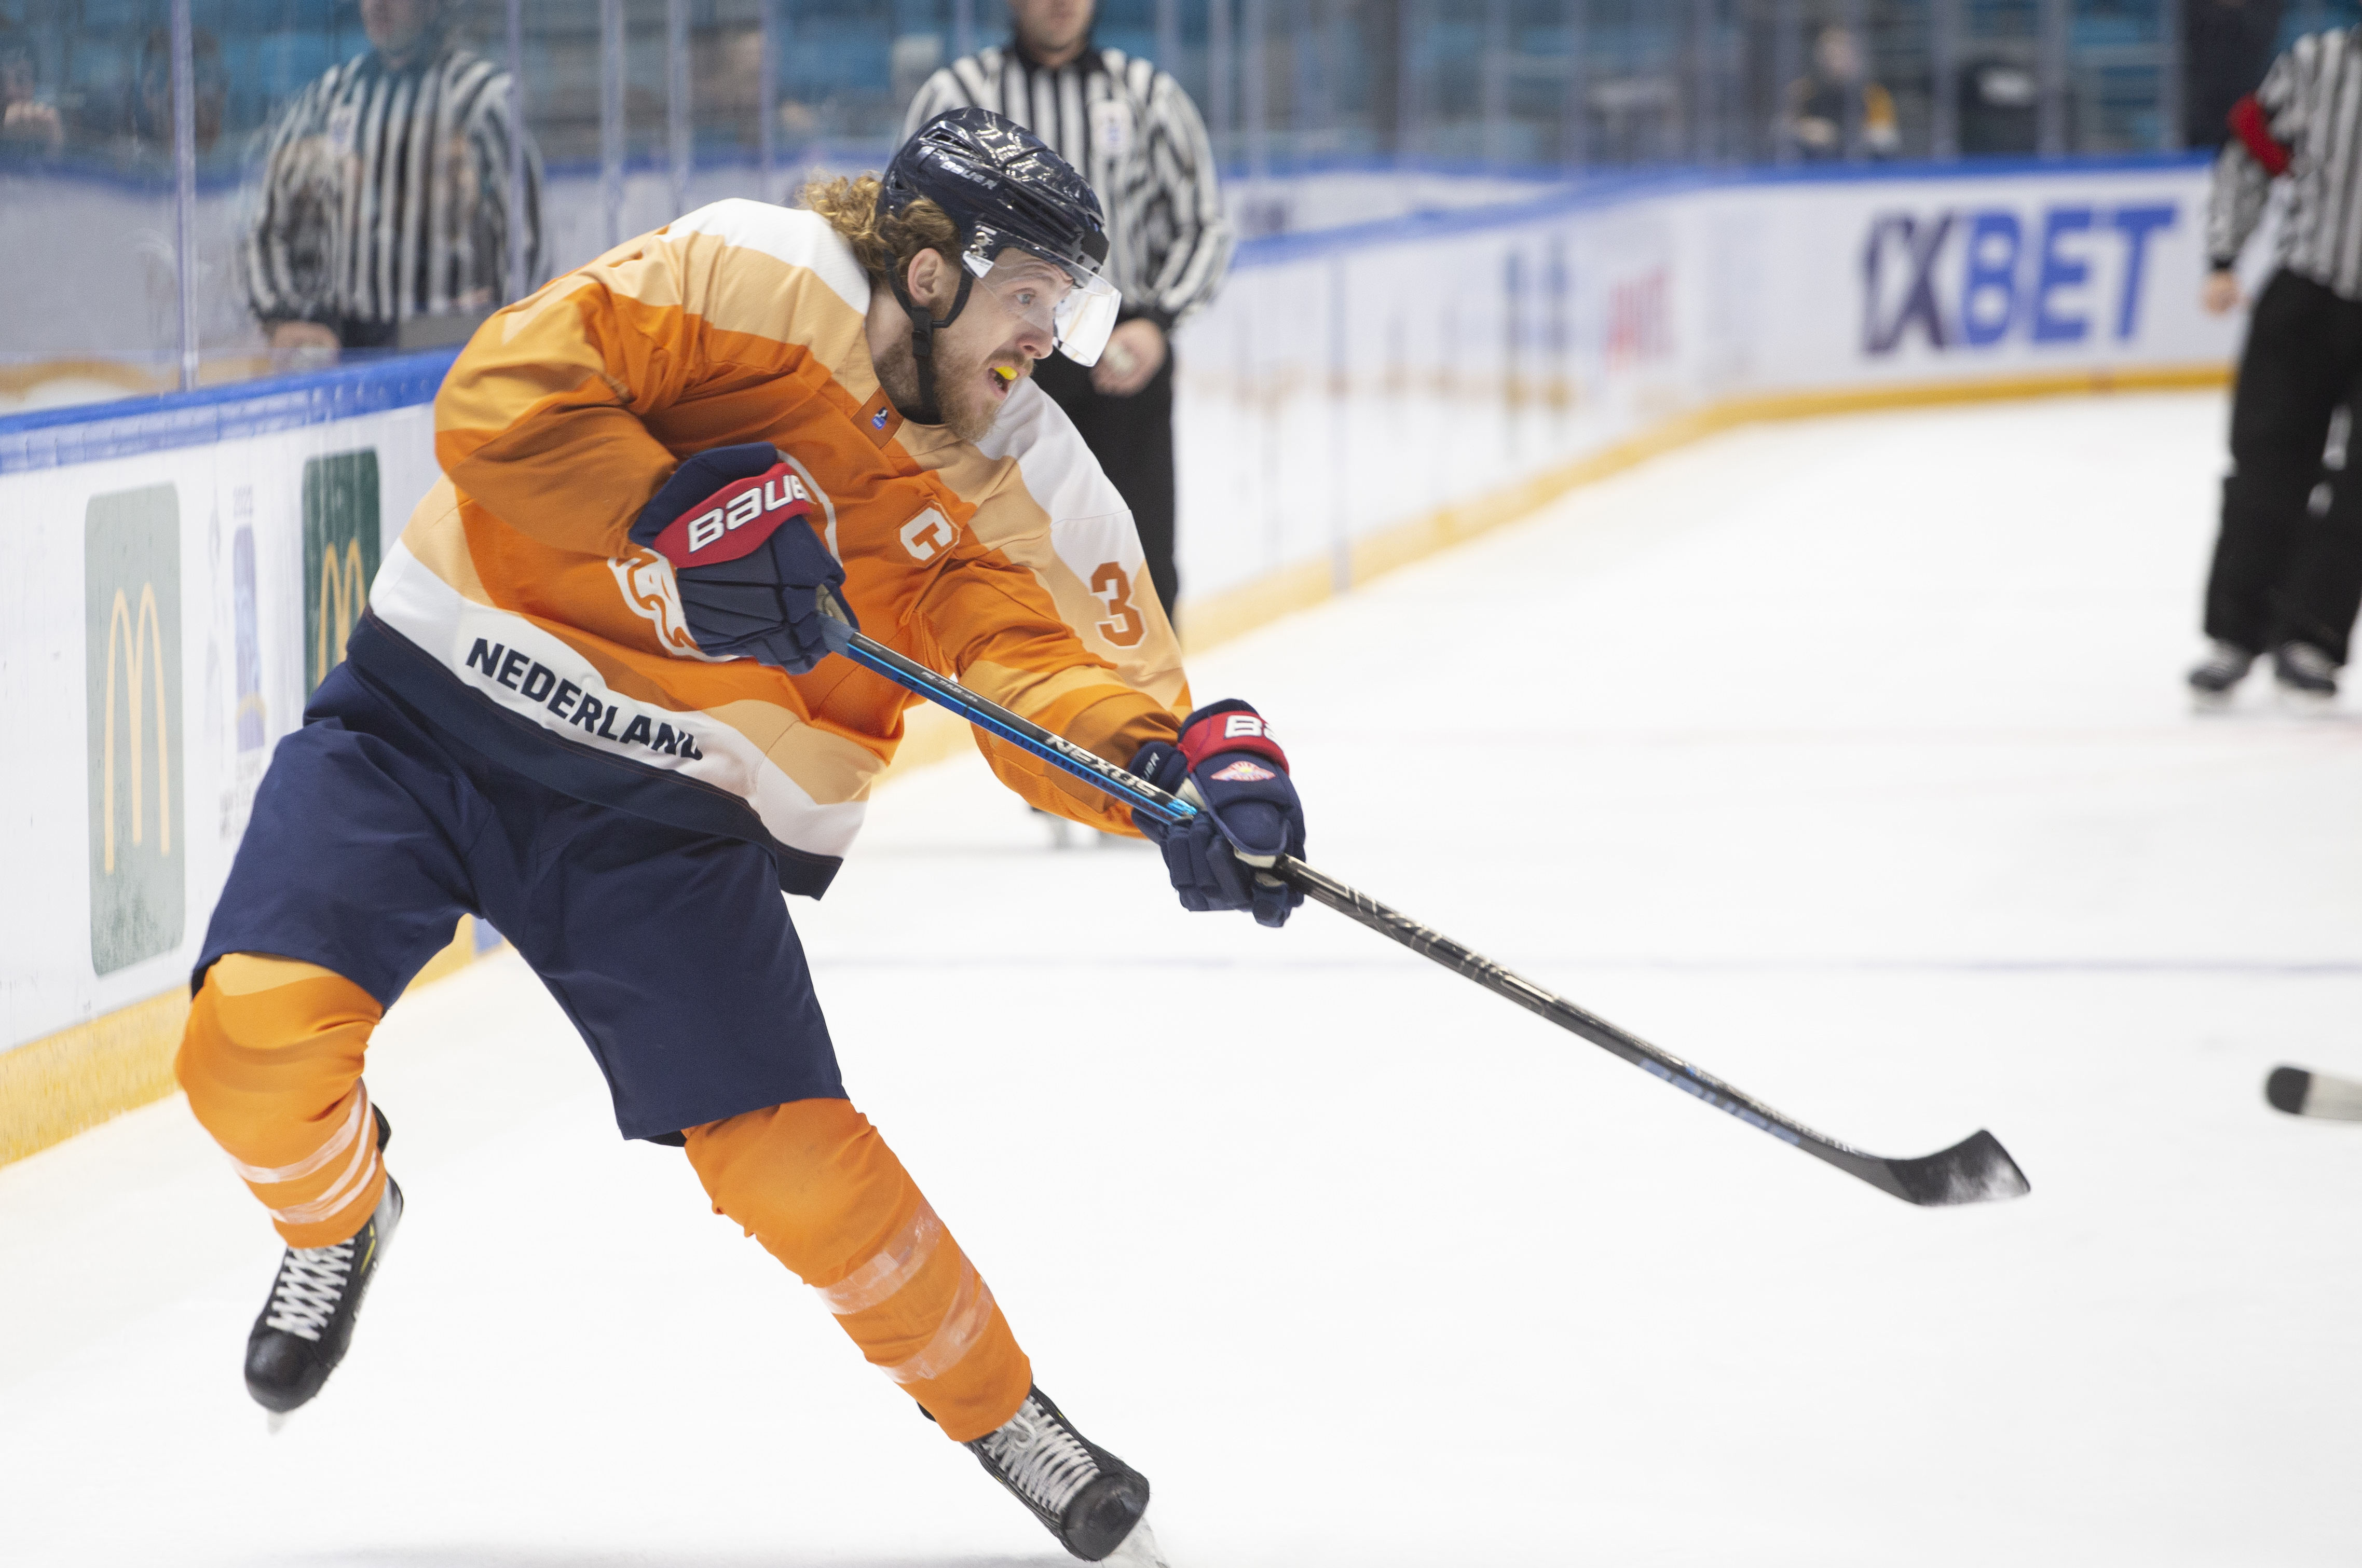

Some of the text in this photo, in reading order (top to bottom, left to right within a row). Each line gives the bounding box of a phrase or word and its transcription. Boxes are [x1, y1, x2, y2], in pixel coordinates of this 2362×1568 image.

[900, 506, 953, 561] C
[1090, 561, 1147, 649] 3
[465, 637, 703, 761] NEDERLAND
[1046, 734, 1160, 797] NEXUS
